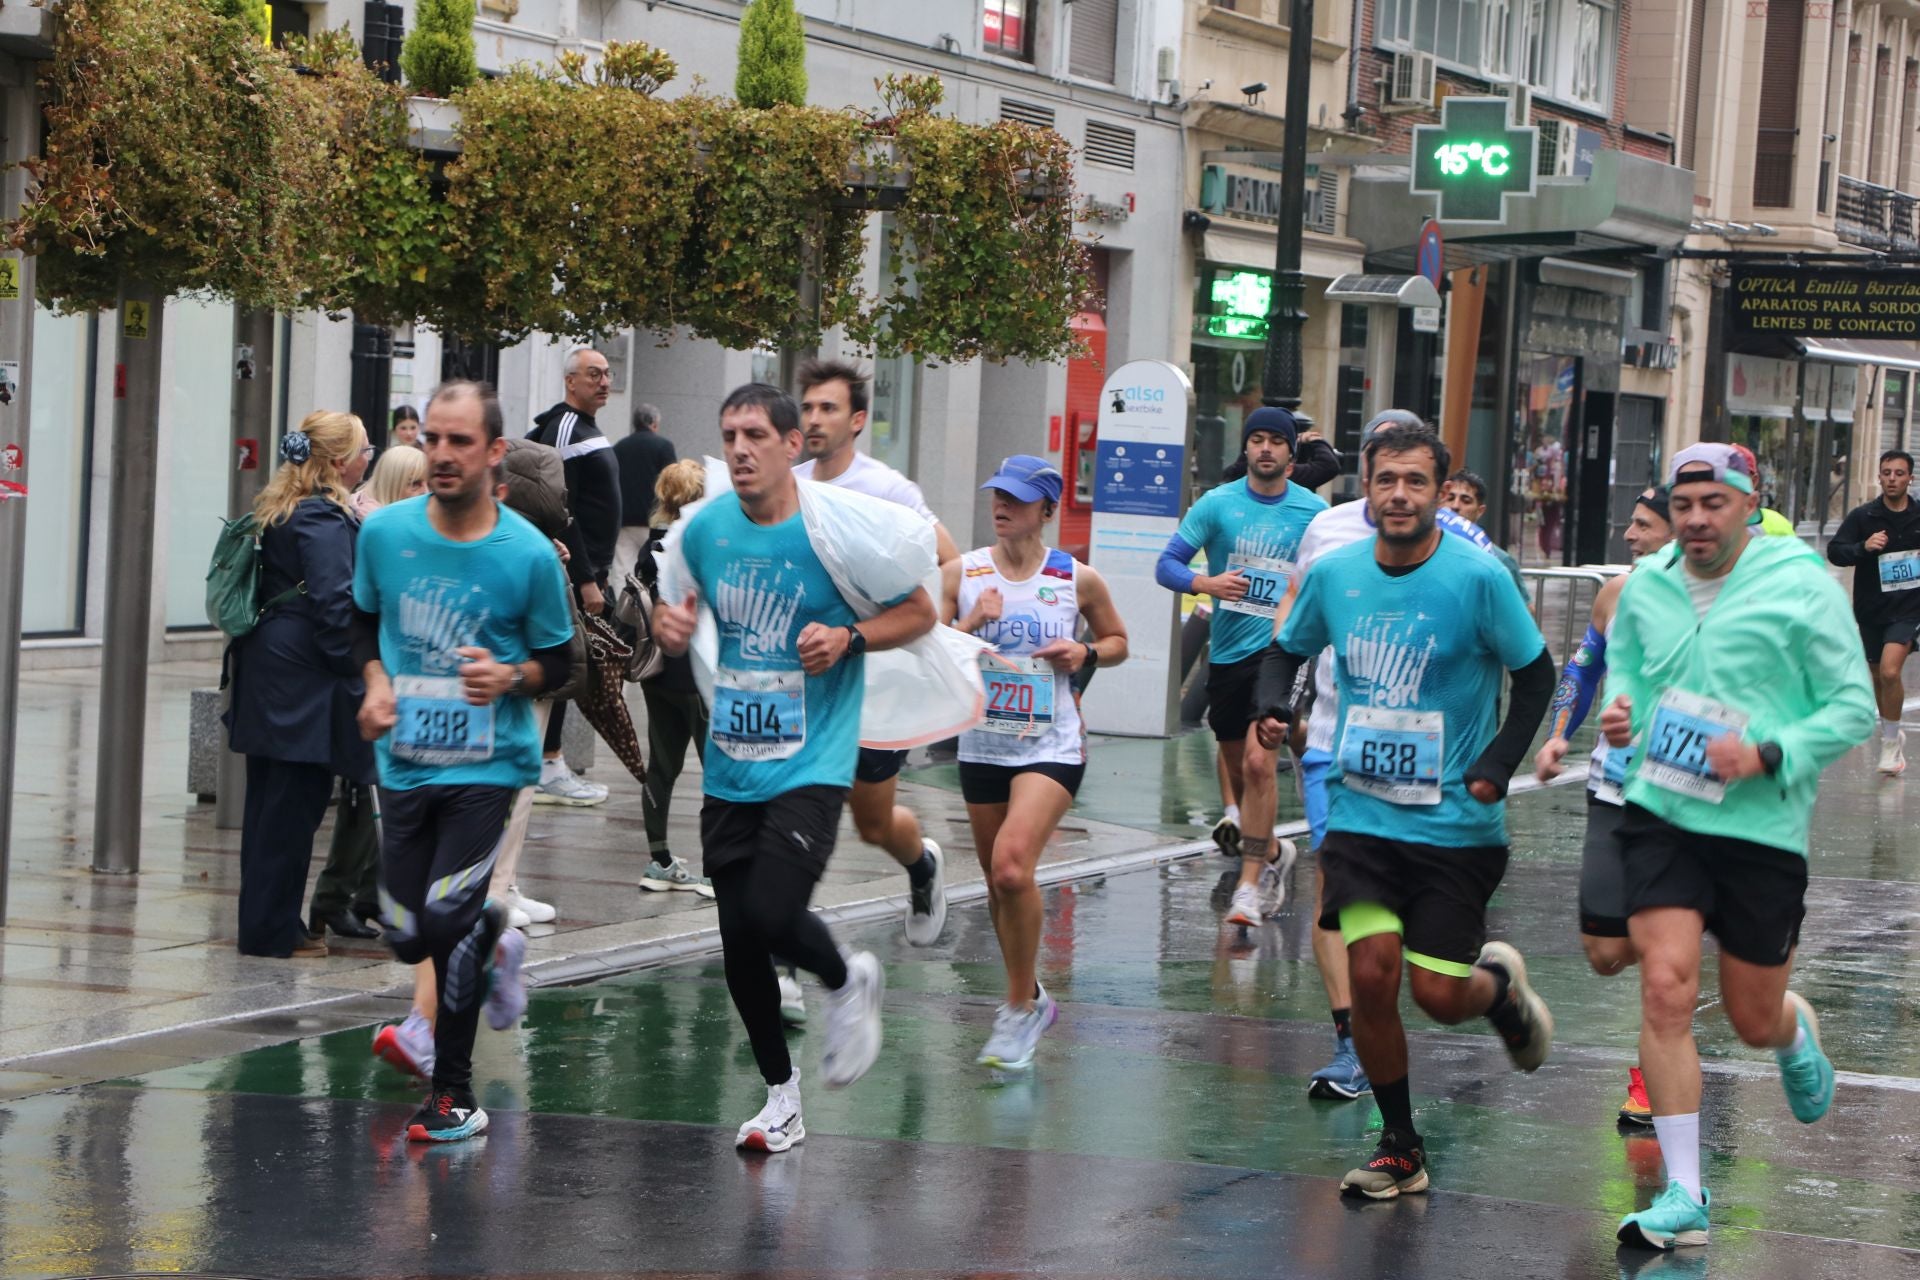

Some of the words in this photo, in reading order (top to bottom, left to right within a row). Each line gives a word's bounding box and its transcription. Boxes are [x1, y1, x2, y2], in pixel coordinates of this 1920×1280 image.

[1738, 278, 1796, 293] OPTICA
[1804, 279, 1858, 295] Emilia
[1741, 298, 1818, 312] APARATOS
[1823, 300, 1862, 313] PARA
[1752, 316, 1806, 329] LENTES
[1813, 318, 1832, 330] DE
[1839, 319, 1916, 333] CONTACTO
[1125, 386, 1164, 401] alsa
[988, 681, 1034, 713] 220
[414, 708, 469, 743] 398
[730, 700, 782, 734] 504
[1361, 740, 1416, 776] 638
